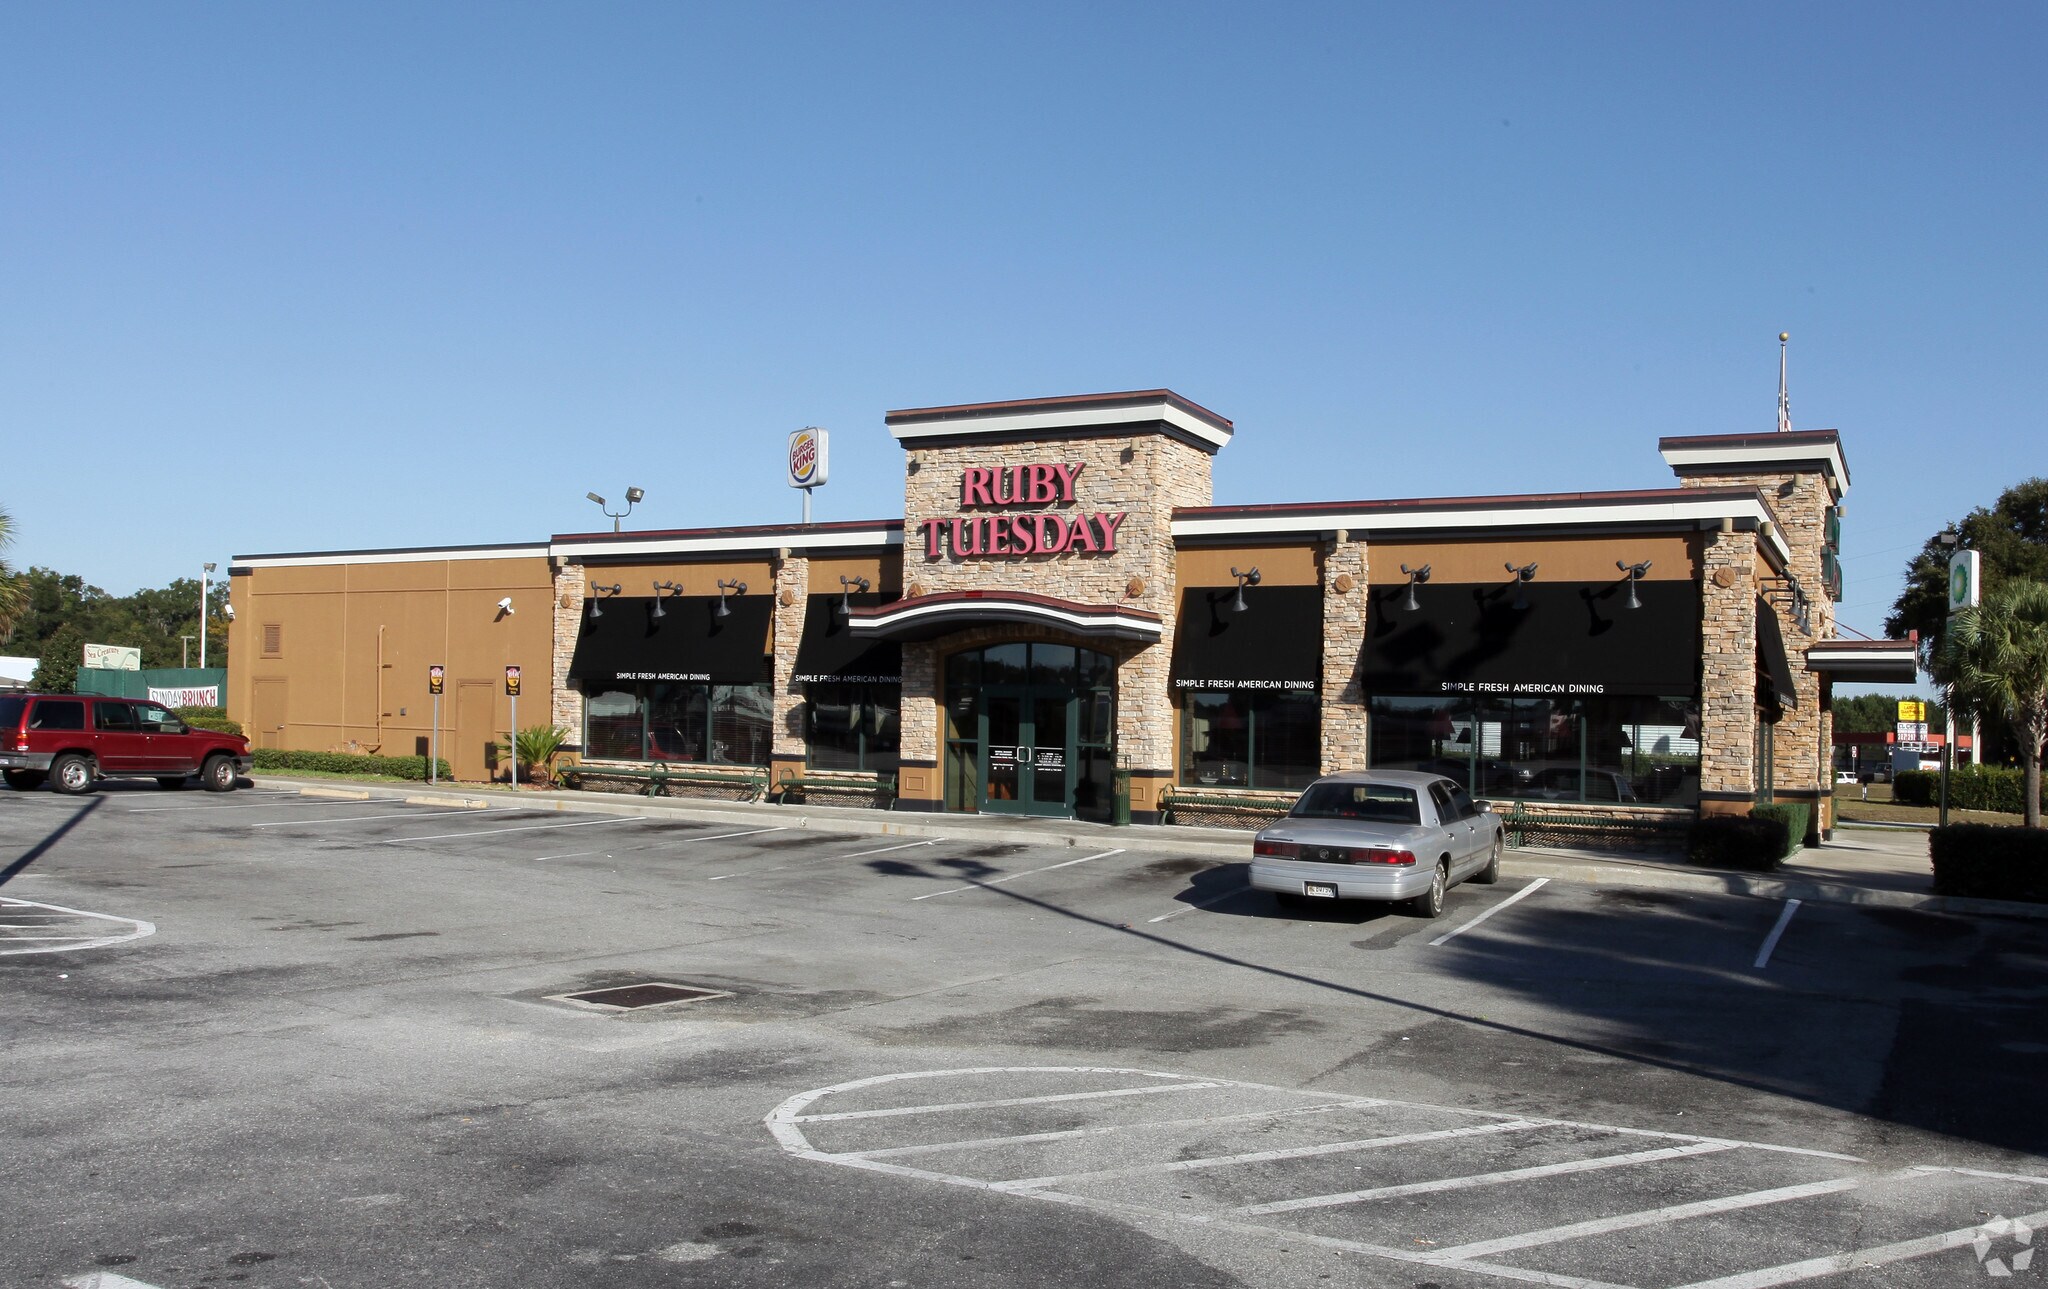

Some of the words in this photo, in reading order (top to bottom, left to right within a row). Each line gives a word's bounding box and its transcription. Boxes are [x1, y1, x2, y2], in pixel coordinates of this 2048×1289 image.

[793, 439, 814, 461] BURGER
[793, 448, 815, 474] KING
[962, 462, 1087, 506] RUBY
[922, 512, 1127, 557] TUESDAY
[616, 672, 636, 680] SIMPLE
[637, 672, 656, 680] FRESH
[657, 672, 688, 681] AMERICAN
[689, 673, 711, 681] DINING
[795, 674, 818, 682] SIMPLE
[819, 674, 840, 683] FRESH
[842, 675, 877, 683] AMERICAN
[879, 675, 902, 683] DINING
[1175, 679, 1205, 688] SIMPLE
[1207, 679, 1235, 688] FRESH
[1237, 680, 1281, 689] AMERICAN
[1284, 680, 1315, 689] DINING
[1441, 682, 1475, 691] SIMPLE
[1478, 682, 1509, 692] FRESH
[1513, 683, 1565, 693] AMERICAN
[1568, 684, 1604, 693] DINING
[151, 690, 181, 707] SUNDAY
[182, 688, 217, 707] BRUNCH
